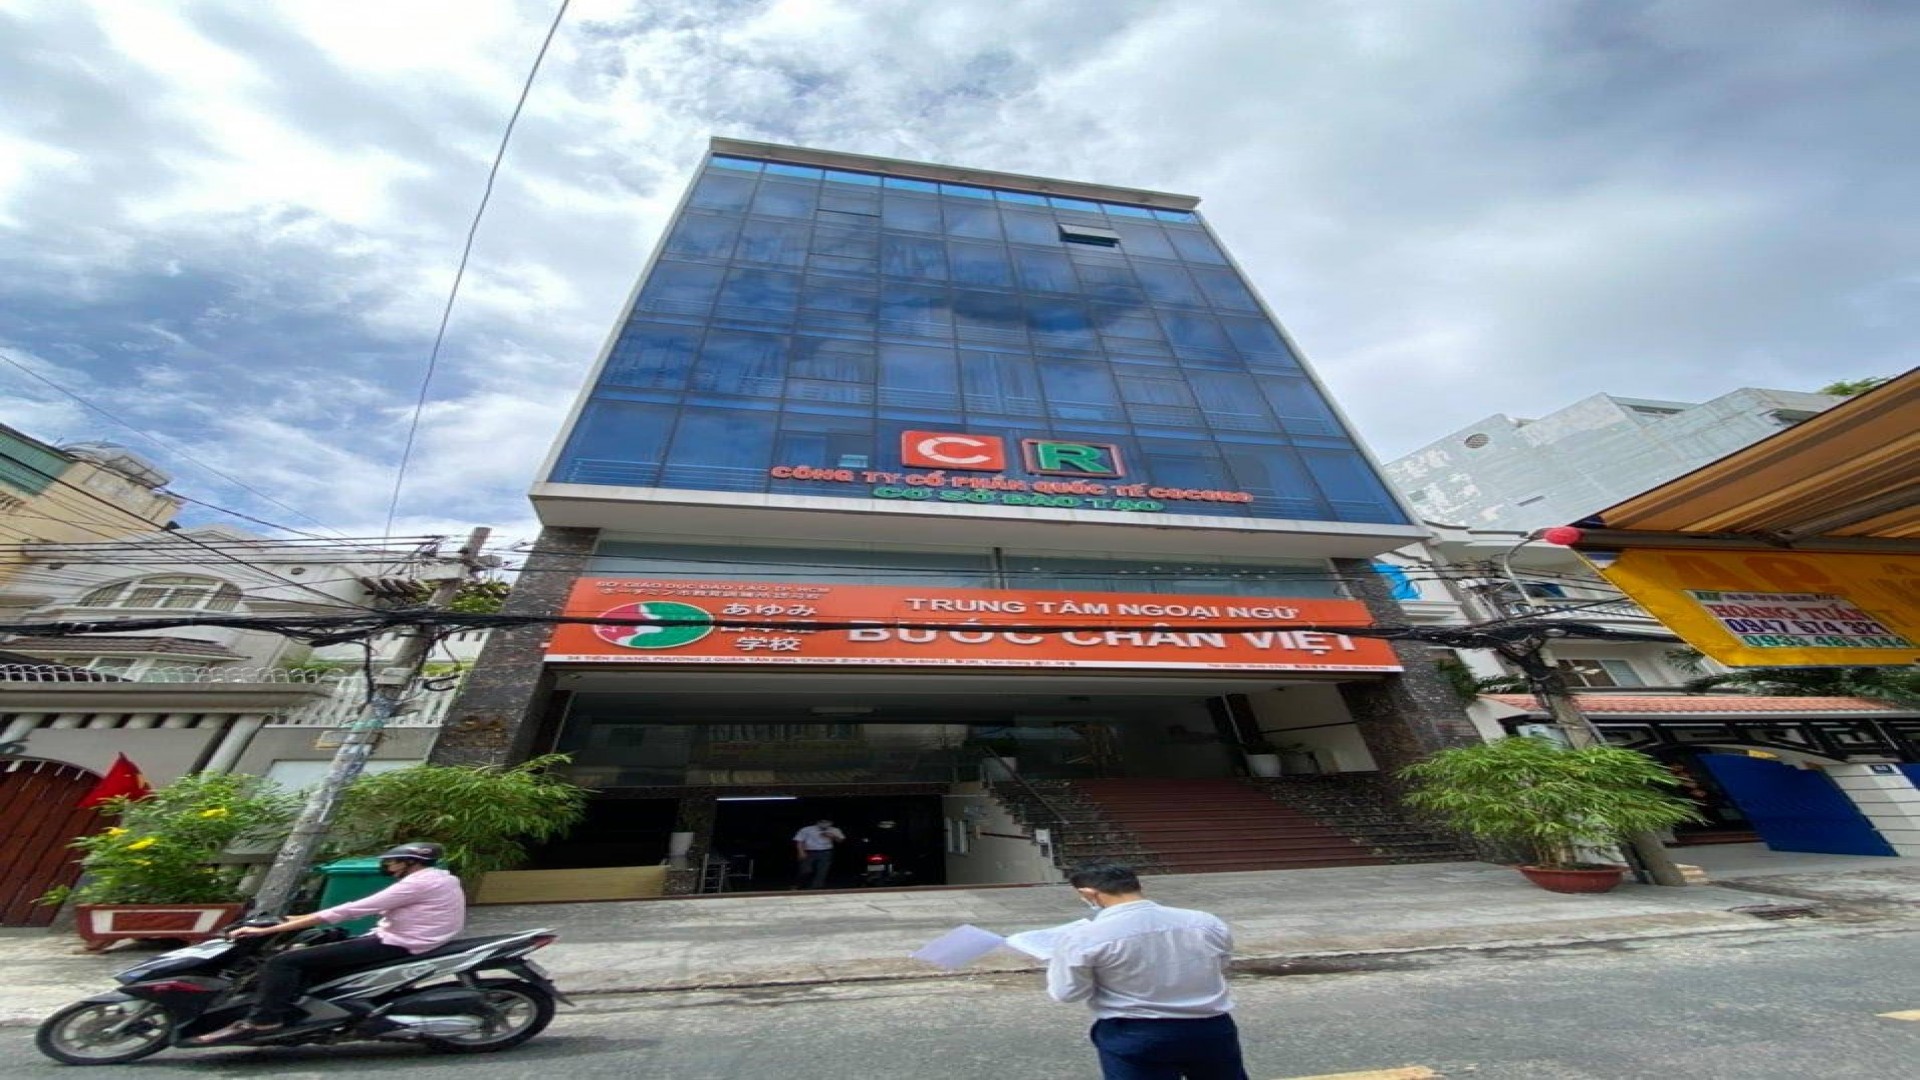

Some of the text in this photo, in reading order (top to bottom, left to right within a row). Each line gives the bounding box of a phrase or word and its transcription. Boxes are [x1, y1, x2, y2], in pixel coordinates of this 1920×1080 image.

[770, 465, 854, 484] CÔNG
[861, 471, 901, 485] TY
[723, 603, 817, 616] あゆみ
[904, 598, 1300, 620] TRUNG TÂM NGOẠI NGỮ
[735, 637, 802, 652] 学校
